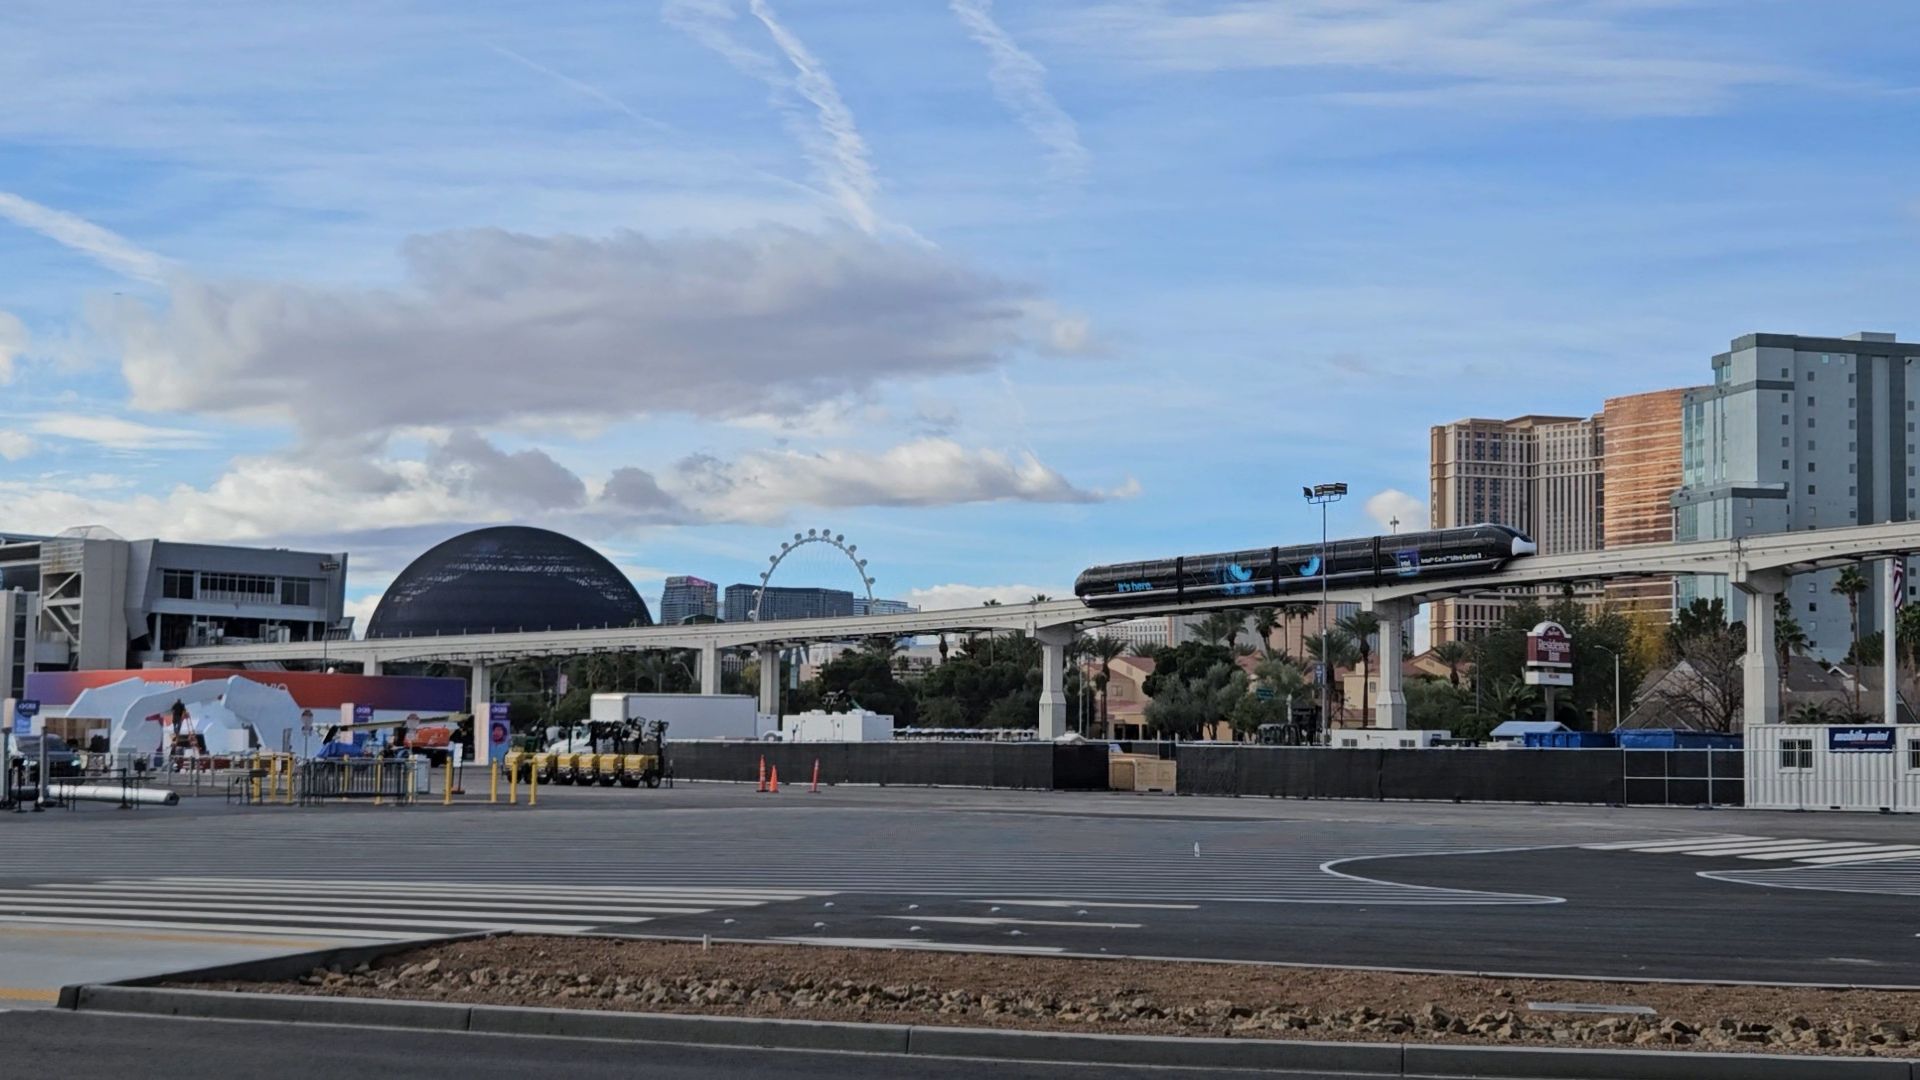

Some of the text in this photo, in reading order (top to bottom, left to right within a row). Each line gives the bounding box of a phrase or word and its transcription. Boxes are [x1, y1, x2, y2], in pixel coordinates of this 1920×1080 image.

[1537, 639, 1570, 653] Residence
[1833, 729, 1890, 741] mobile mini
